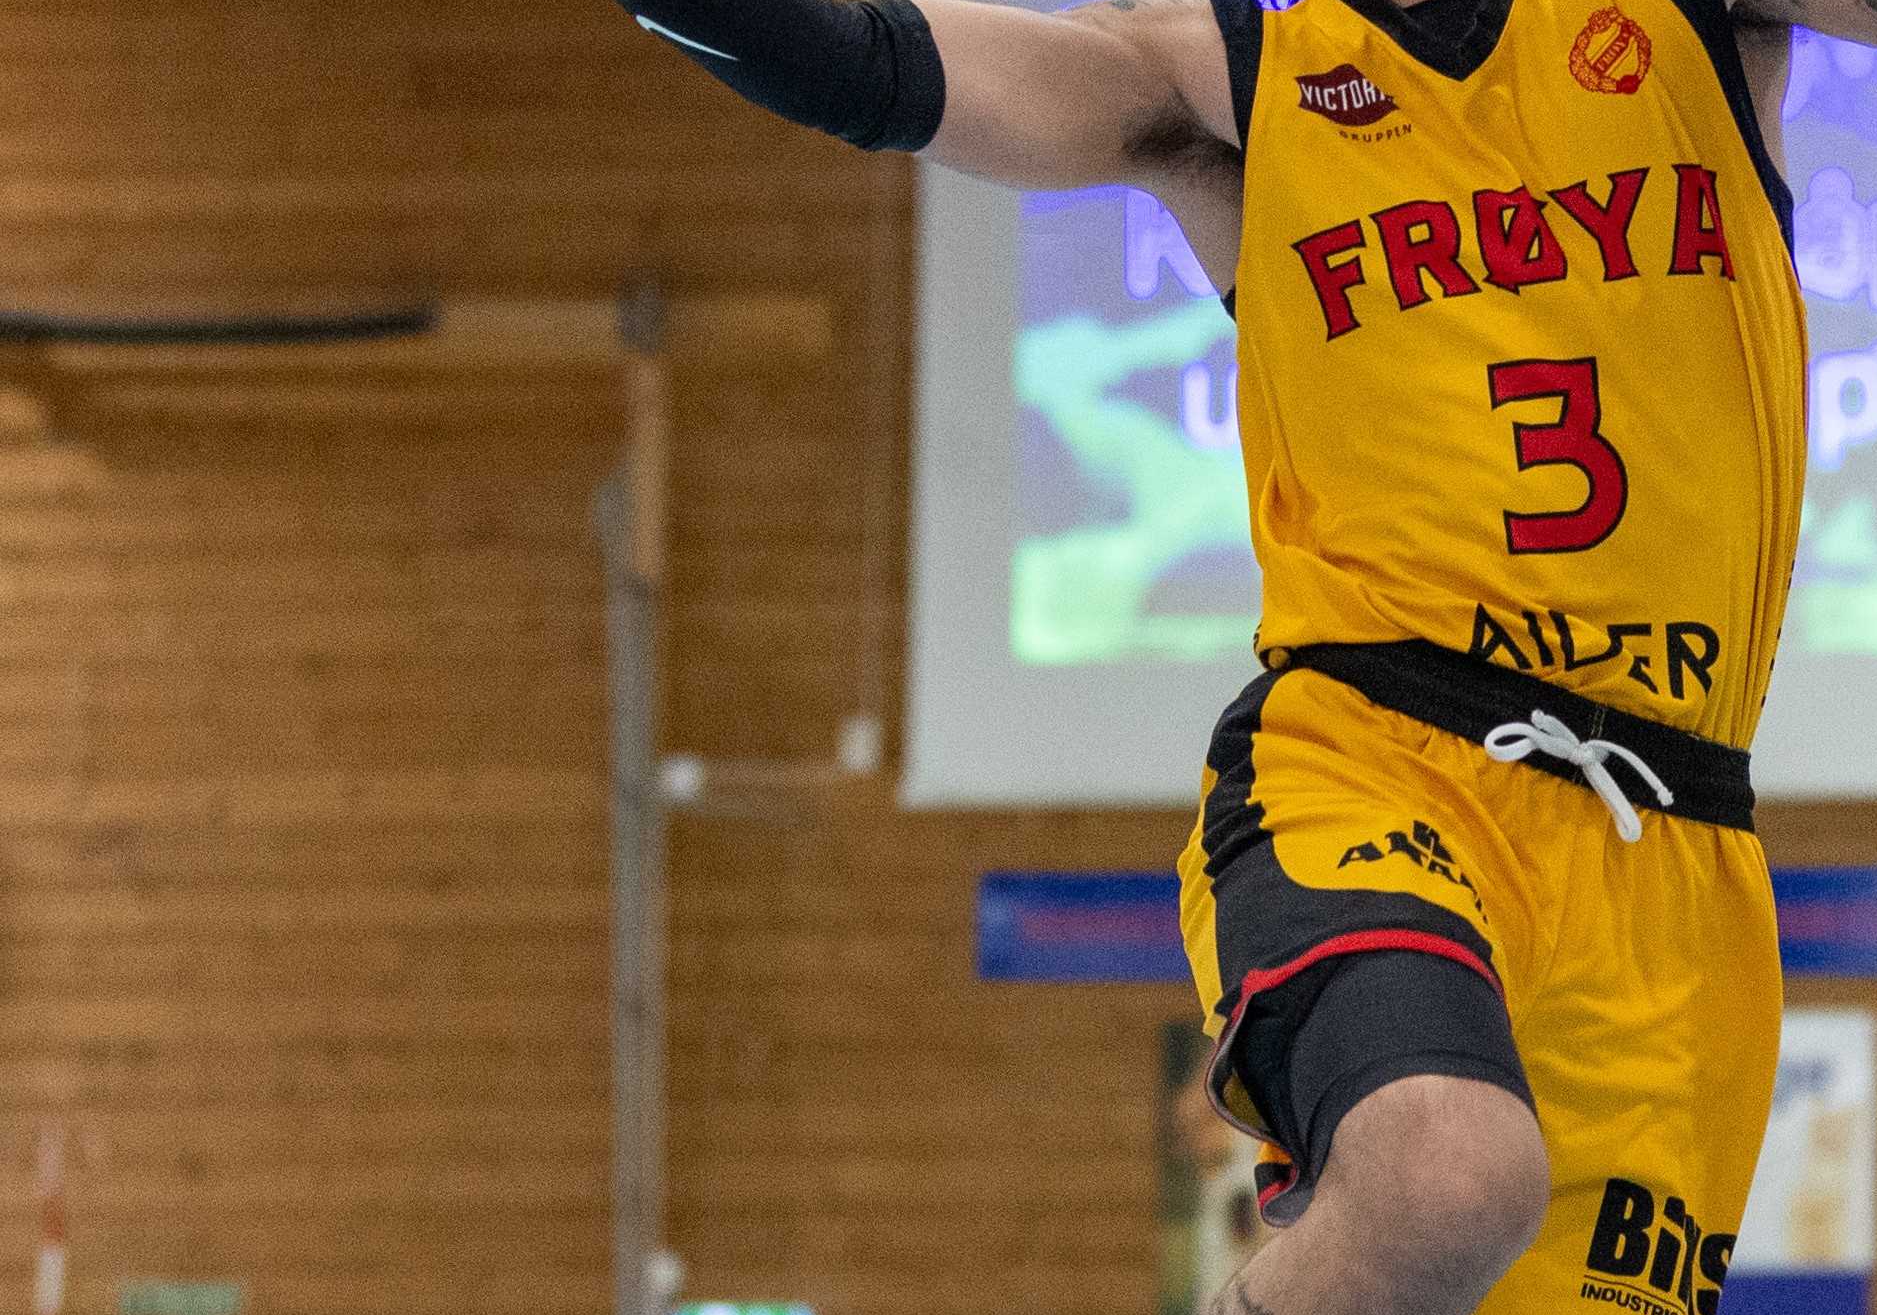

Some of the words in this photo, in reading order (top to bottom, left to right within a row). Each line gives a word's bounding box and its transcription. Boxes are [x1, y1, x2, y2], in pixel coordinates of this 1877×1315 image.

[1301, 78, 1396, 112] VICTOR
[1291, 163, 1737, 343] FRØYA
[1486, 356, 1629, 555] 3
